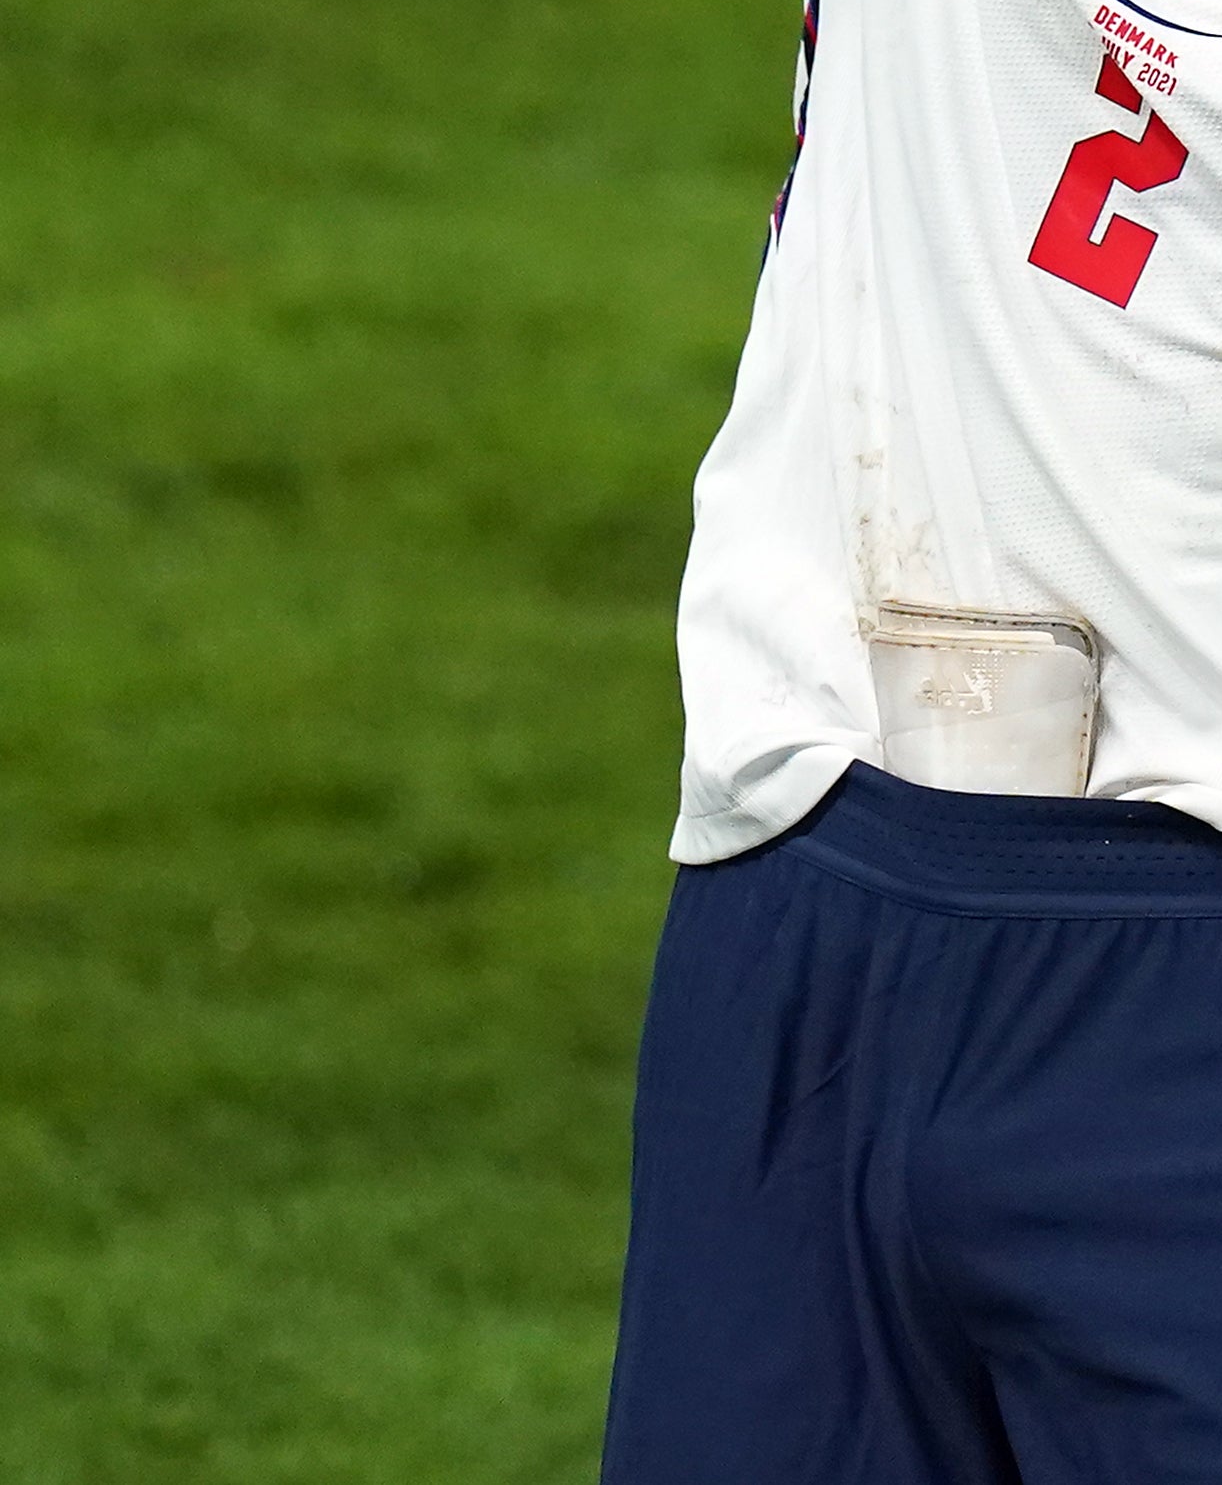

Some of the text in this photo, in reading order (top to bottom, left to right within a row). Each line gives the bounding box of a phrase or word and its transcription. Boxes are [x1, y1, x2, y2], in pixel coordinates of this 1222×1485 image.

[1094, 5, 1178, 68] DENMARK
[1137, 63, 1177, 96] 2021
[1028, 52, 1190, 309] 2
